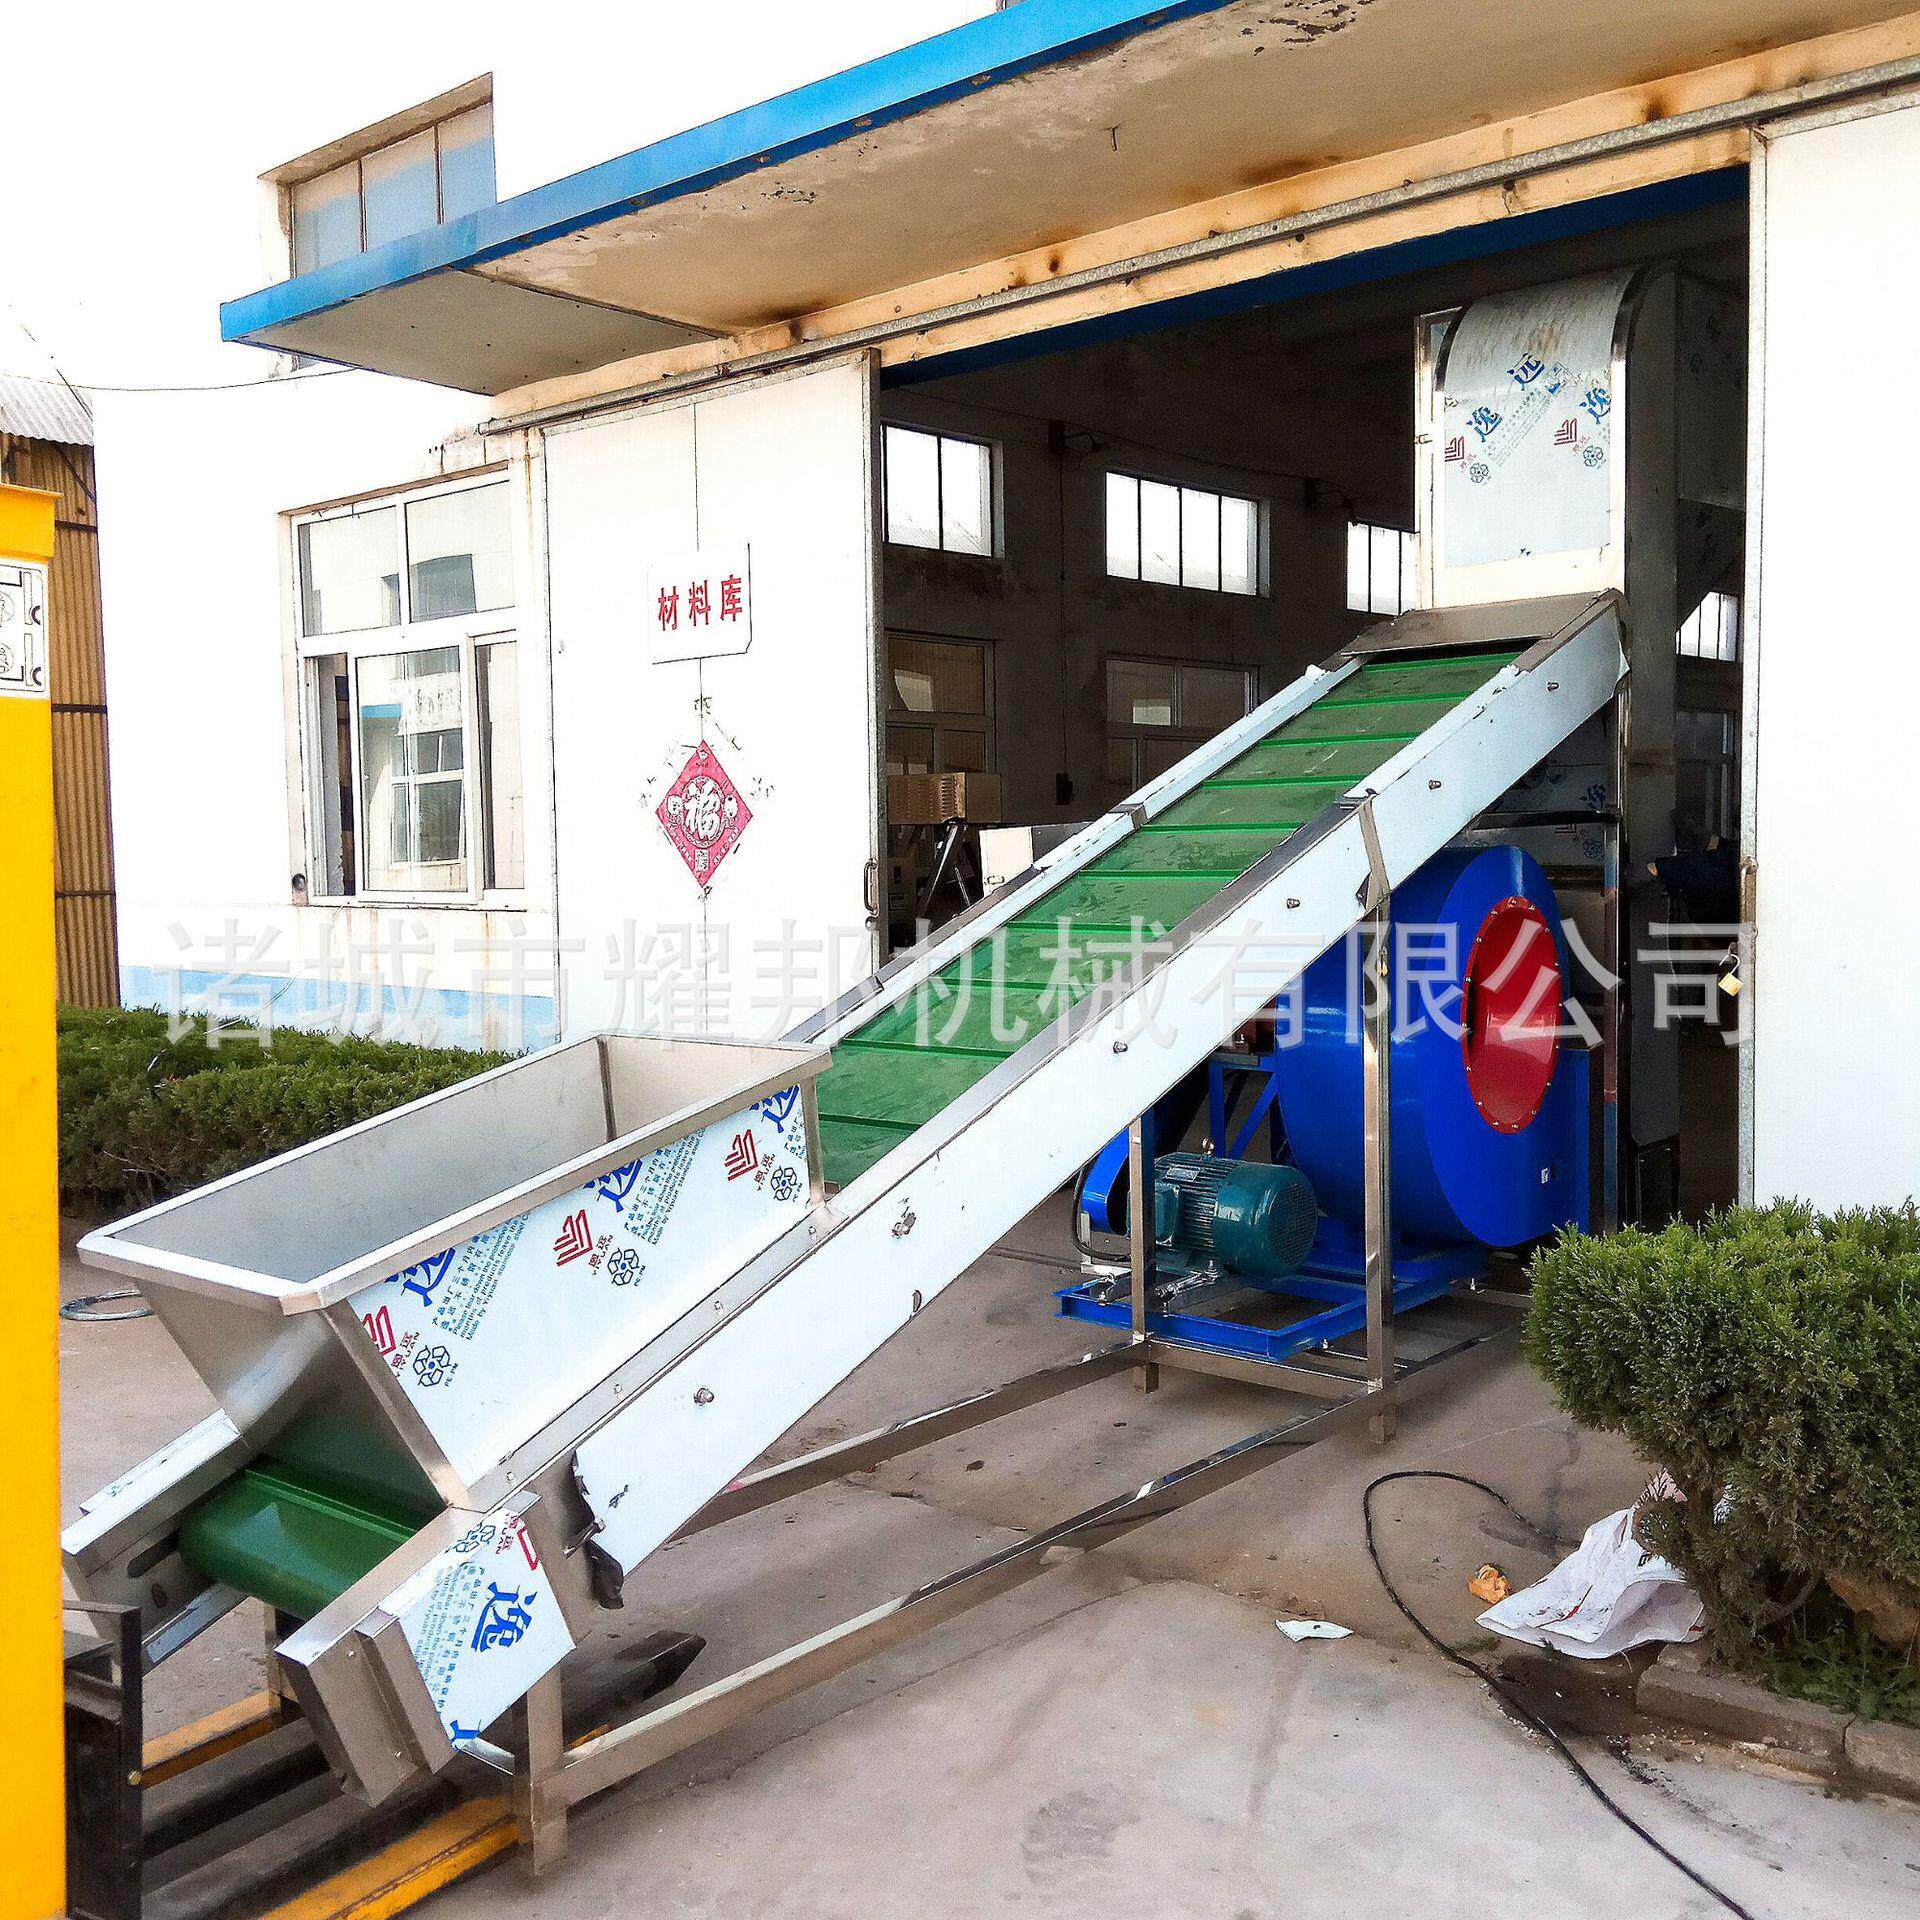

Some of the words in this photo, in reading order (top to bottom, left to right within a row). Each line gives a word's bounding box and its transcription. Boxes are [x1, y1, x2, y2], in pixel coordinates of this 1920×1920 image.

[657, 574, 743, 631] 材料库
[473, 1274, 486, 1294] down
[480, 1258, 500, 1296] products
[482, 1278, 499, 1305] Yiyuan
[498, 1242, 516, 1277] stainless
[471, 1581, 538, 1653] 逸
